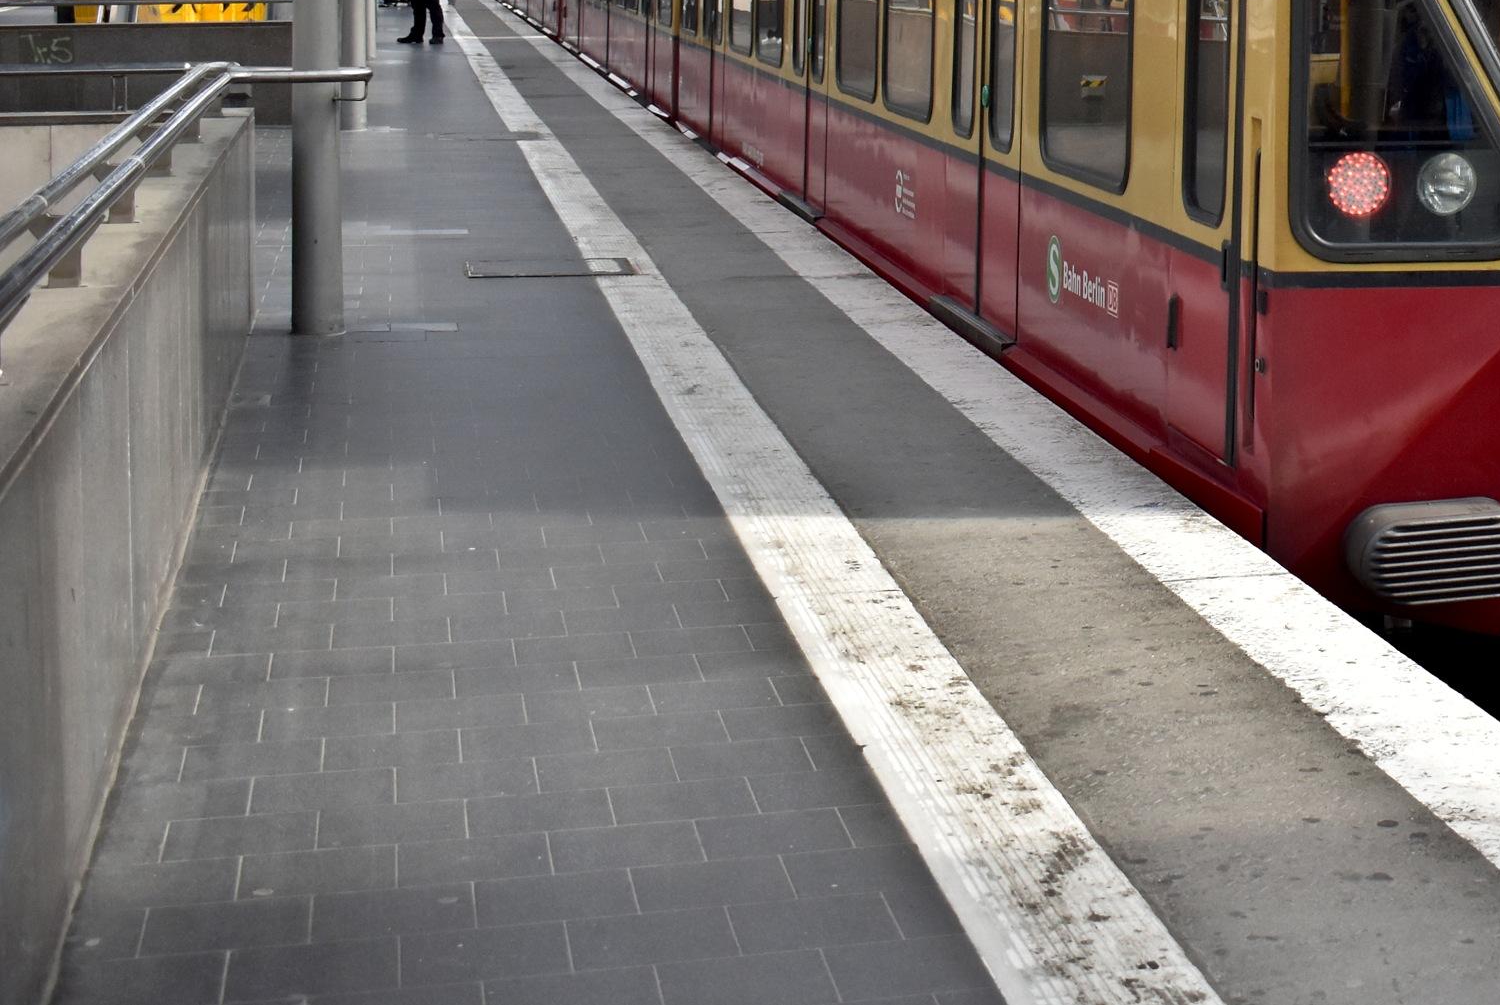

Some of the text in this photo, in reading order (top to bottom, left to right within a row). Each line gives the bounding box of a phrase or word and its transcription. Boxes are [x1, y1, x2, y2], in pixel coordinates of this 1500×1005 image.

[1048, 243, 1118, 315] S Bahn Berlin DB
